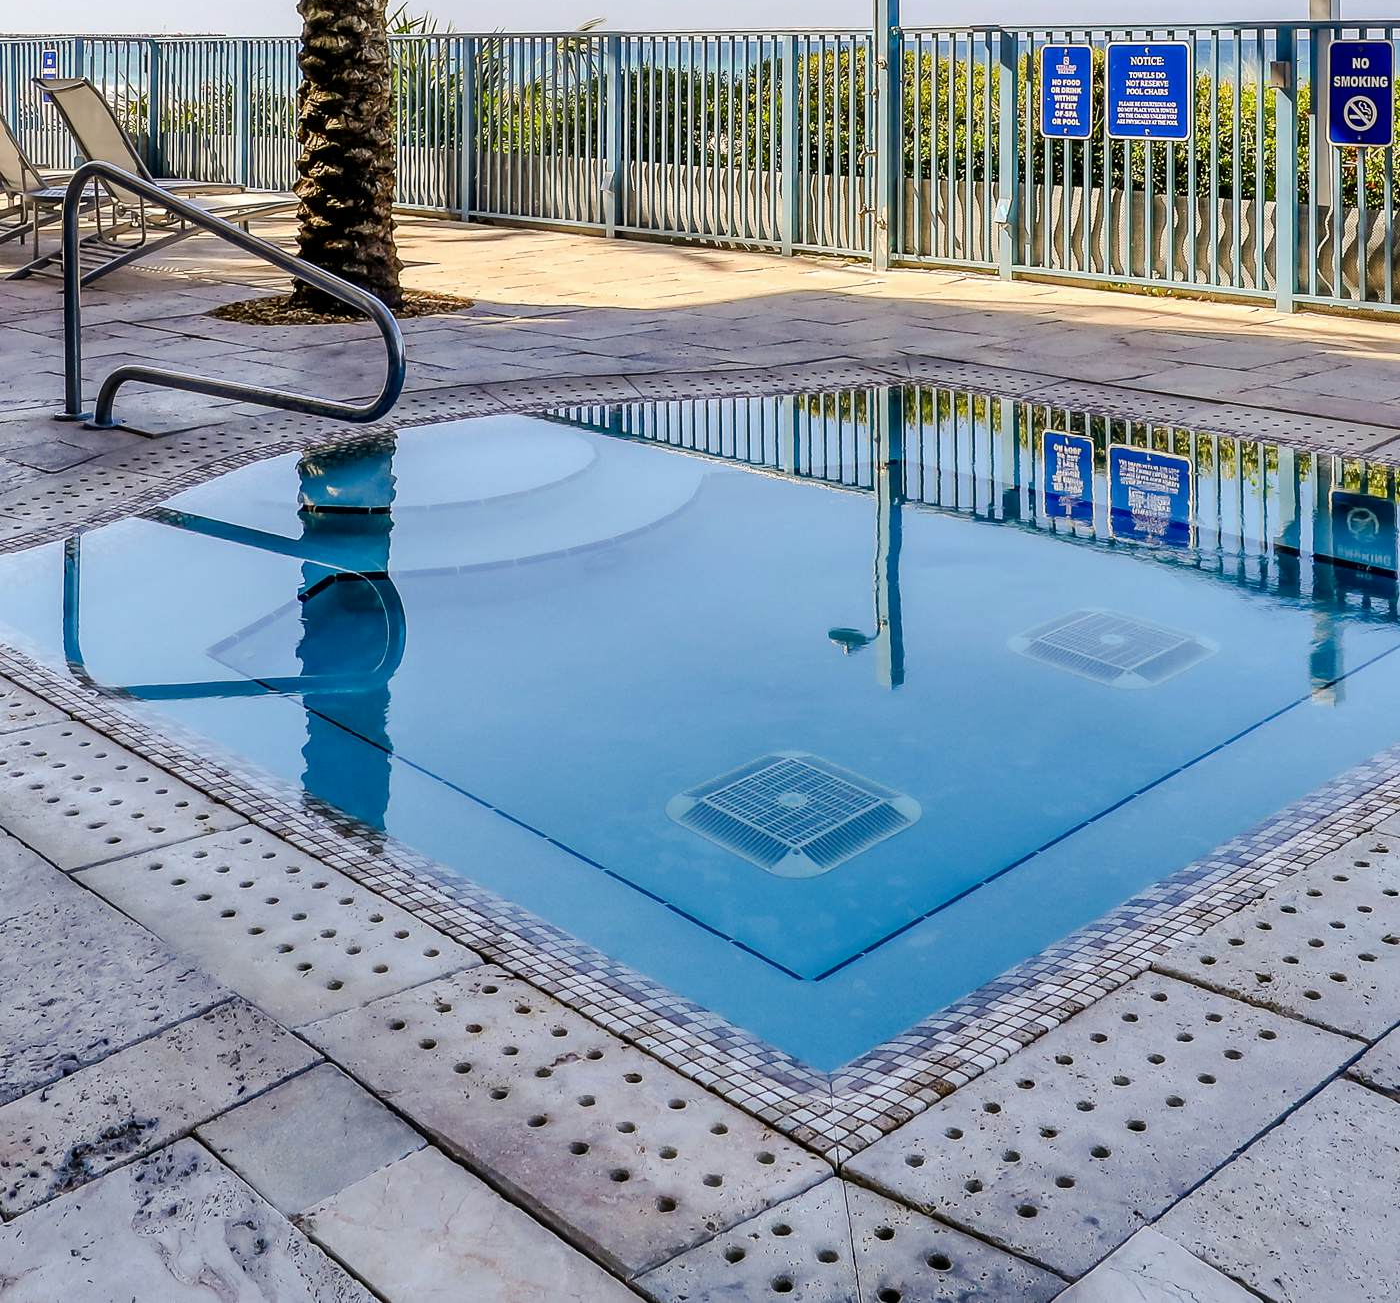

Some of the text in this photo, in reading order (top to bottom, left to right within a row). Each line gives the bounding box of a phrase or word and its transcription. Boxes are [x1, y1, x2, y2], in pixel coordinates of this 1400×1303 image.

[1130, 56, 1164, 66] NOTICE:
[1352, 58, 1370, 69] NO
[1334, 76, 1388, 88] SMOKING
